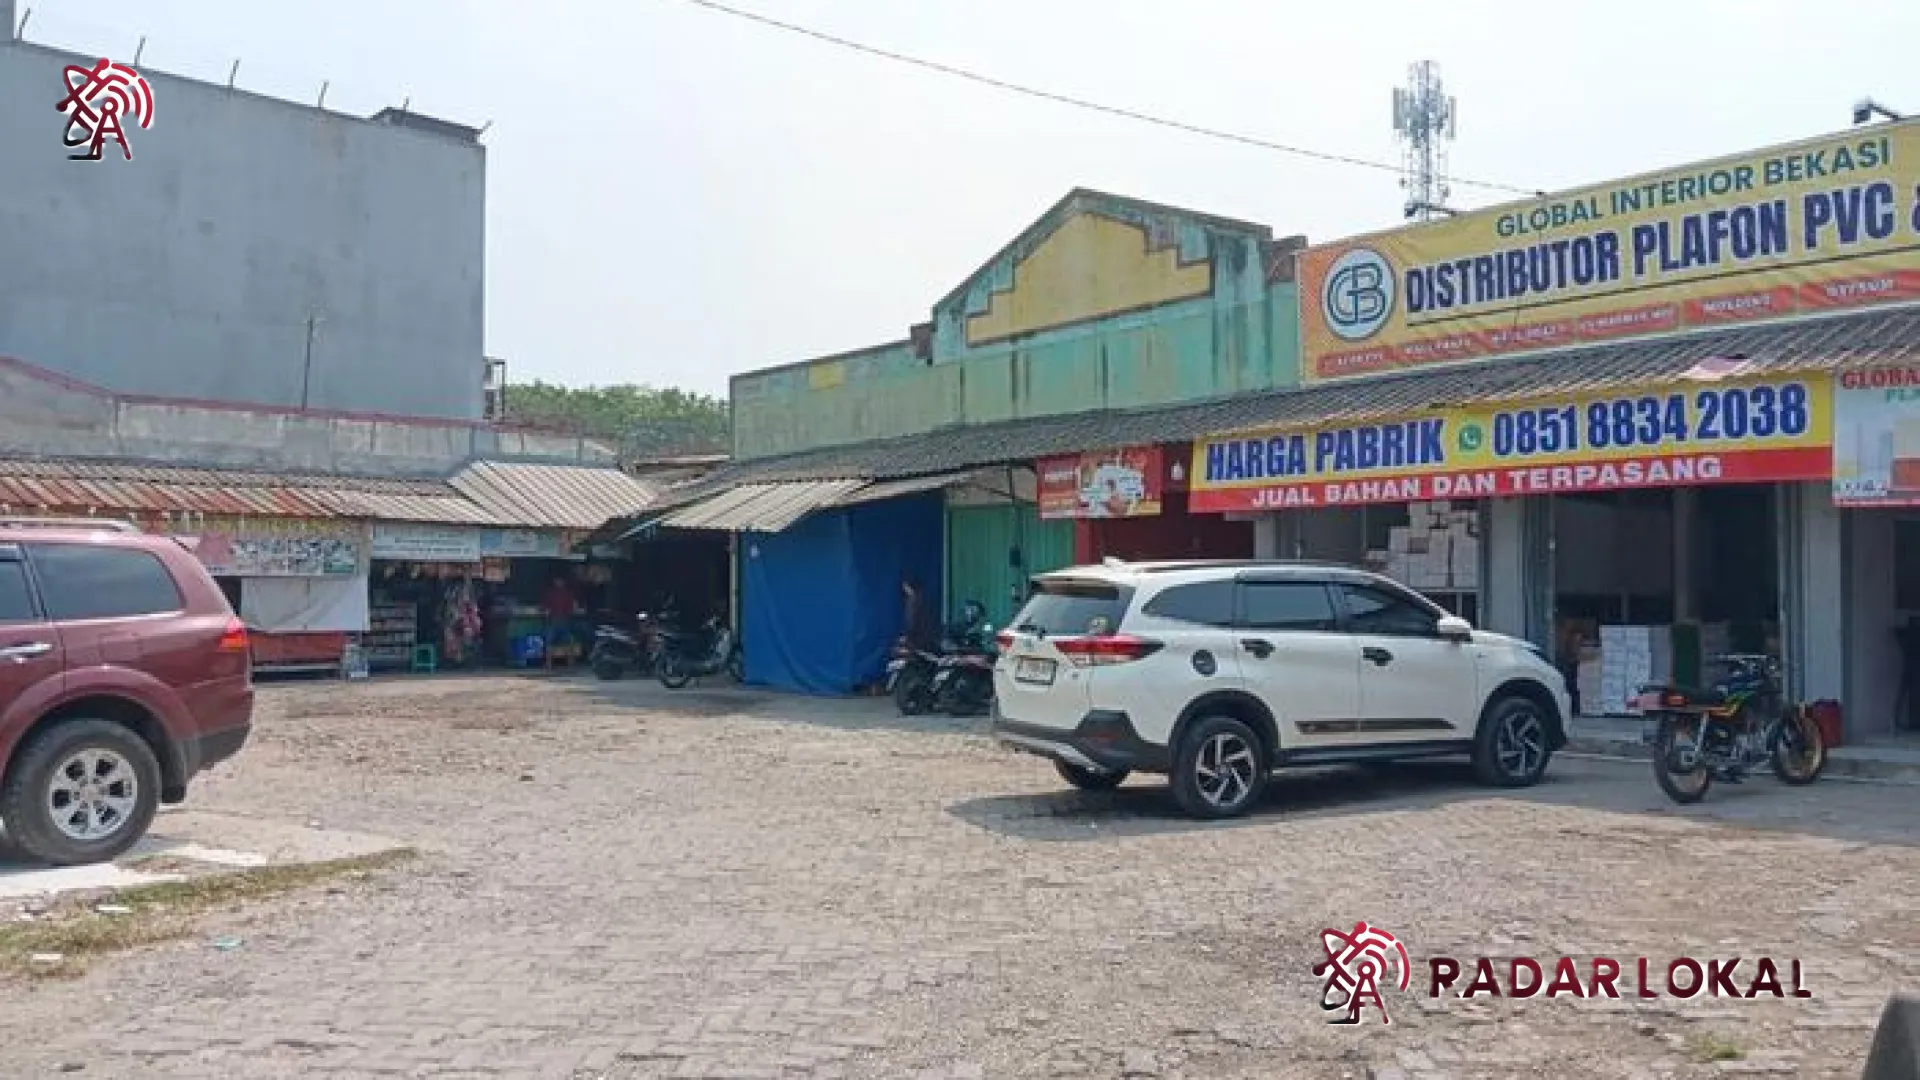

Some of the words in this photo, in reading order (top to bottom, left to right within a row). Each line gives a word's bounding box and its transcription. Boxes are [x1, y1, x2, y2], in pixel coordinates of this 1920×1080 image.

[1496, 197, 1603, 237] GLOBAL
[1610, 165, 1754, 214] INTERIOR
[1764, 137, 1890, 185] BEKASI
[1406, 232, 1620, 313] DISTRIBUTOR
[1632, 199, 1788, 276] PLAFON
[1804, 182, 1894, 250] PVC
[1207, 435, 1306, 480] HARGA
[1316, 419, 1444, 472] PABRIK
[1493, 407, 1577, 456] 0851
[1588, 395, 1687, 447] 8834
[1696, 384, 1806, 440] 2038
[1253, 487, 1314, 508] JUAL
[1325, 475, 1419, 502] BAHAN
[1433, 472, 1495, 496] DAN
[1508, 457, 1722, 491] TERPASANG
